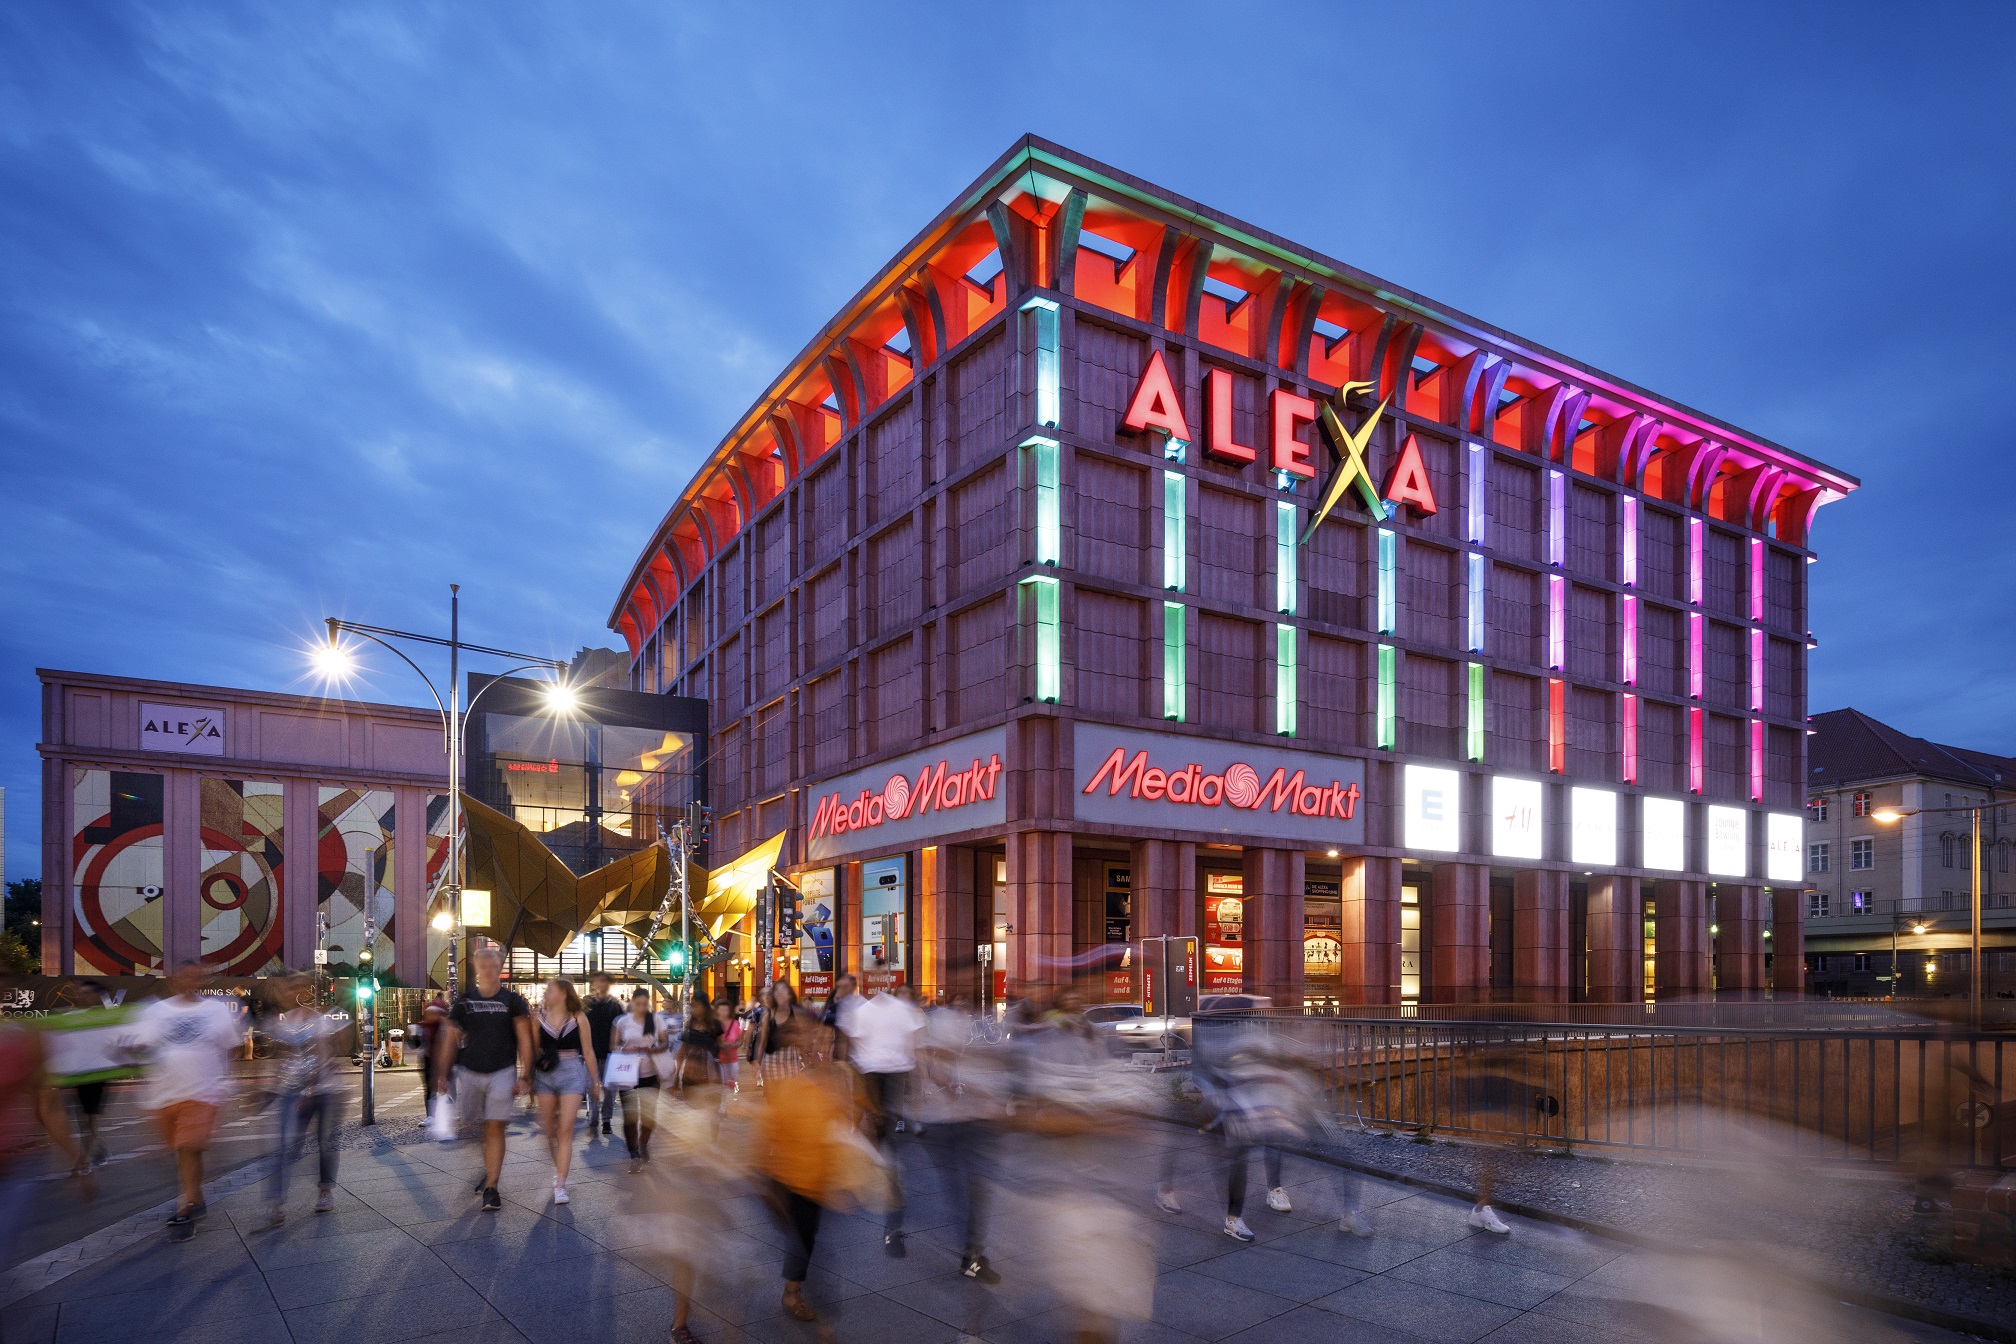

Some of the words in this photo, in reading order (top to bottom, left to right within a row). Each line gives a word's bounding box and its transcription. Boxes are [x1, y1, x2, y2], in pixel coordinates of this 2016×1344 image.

[1117, 348, 1437, 546] ALEXA
[144, 716, 222, 746] ALEXA
[808, 792, 885, 840] Media
[903, 754, 1002, 818] Markt
[1082, 748, 1225, 806] Media
[1251, 768, 1360, 819] Markt
[1421, 788, 1443, 821] E
[1715, 816, 1739, 830] Lounge
[1715, 829, 1740, 843] Bowling
